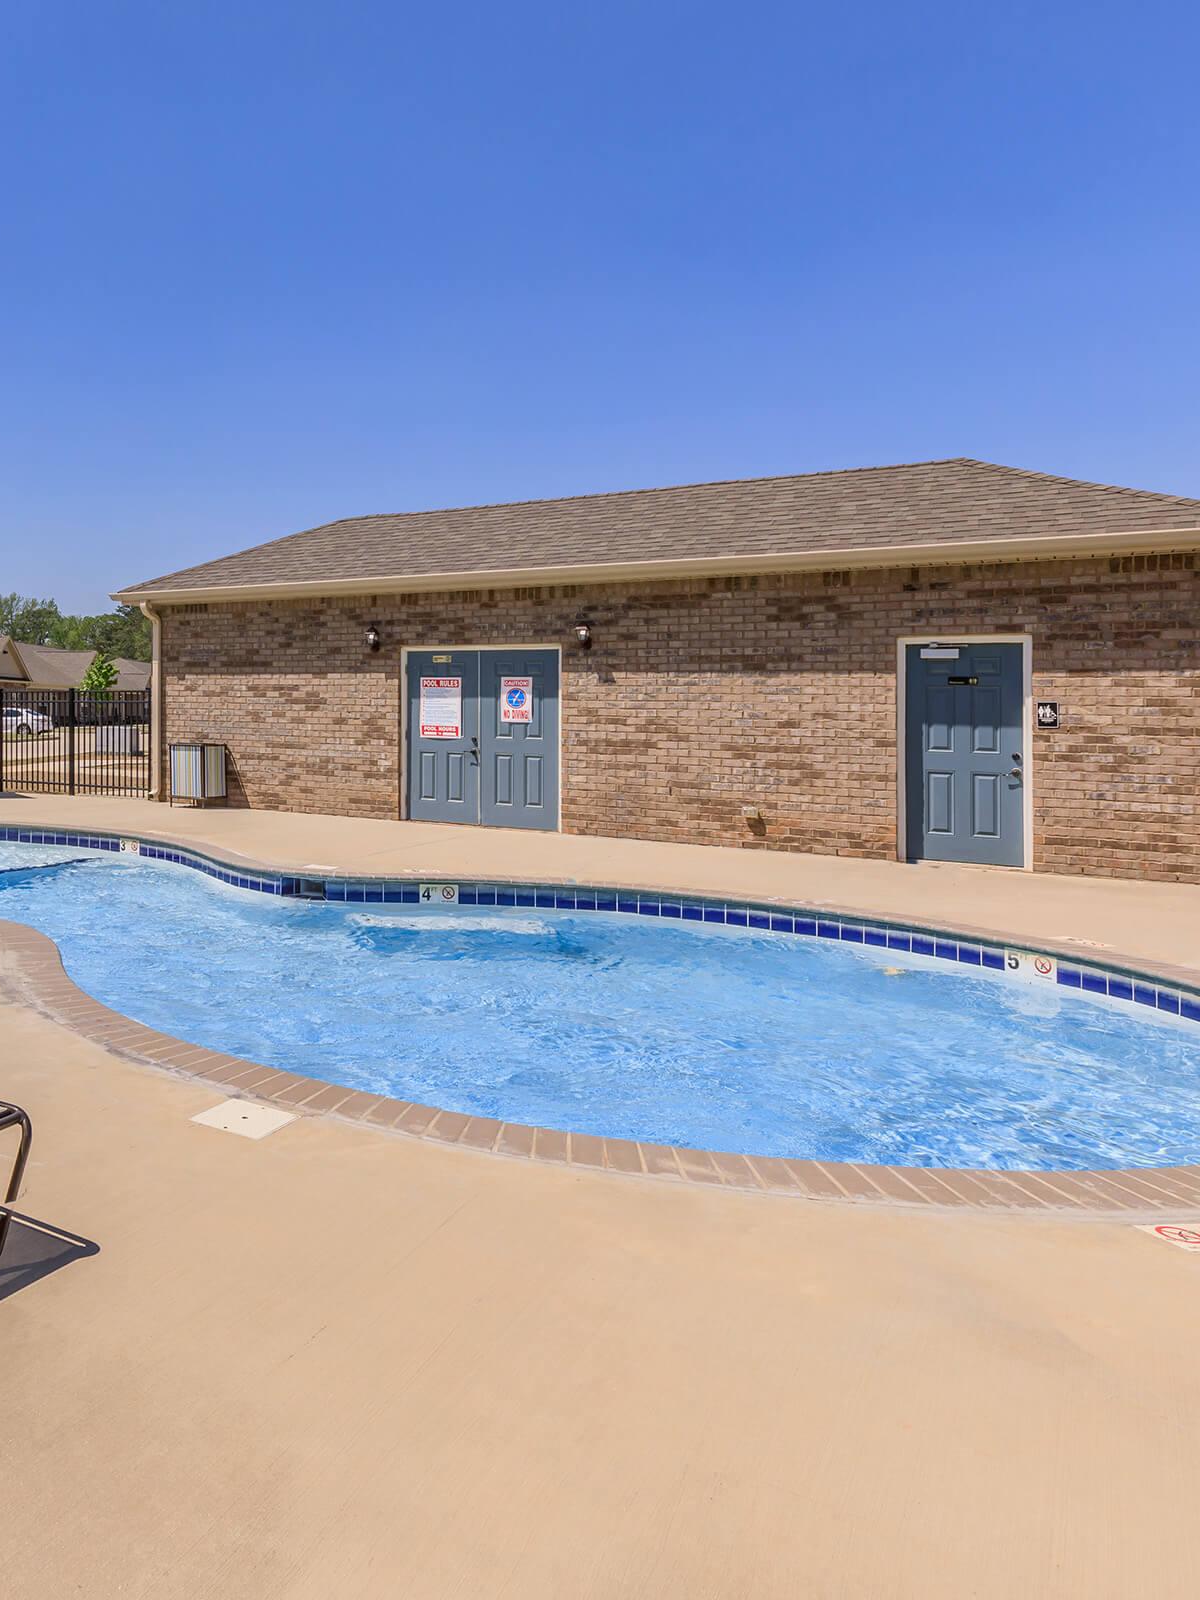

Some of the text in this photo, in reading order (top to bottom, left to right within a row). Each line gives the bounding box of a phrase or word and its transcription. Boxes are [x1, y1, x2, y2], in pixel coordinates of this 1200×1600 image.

[423, 680, 459, 688] POOL RULES
[503, 710, 511, 719] NO
[421, 887, 432, 901] 4
[1007, 952, 1020, 970] 5
